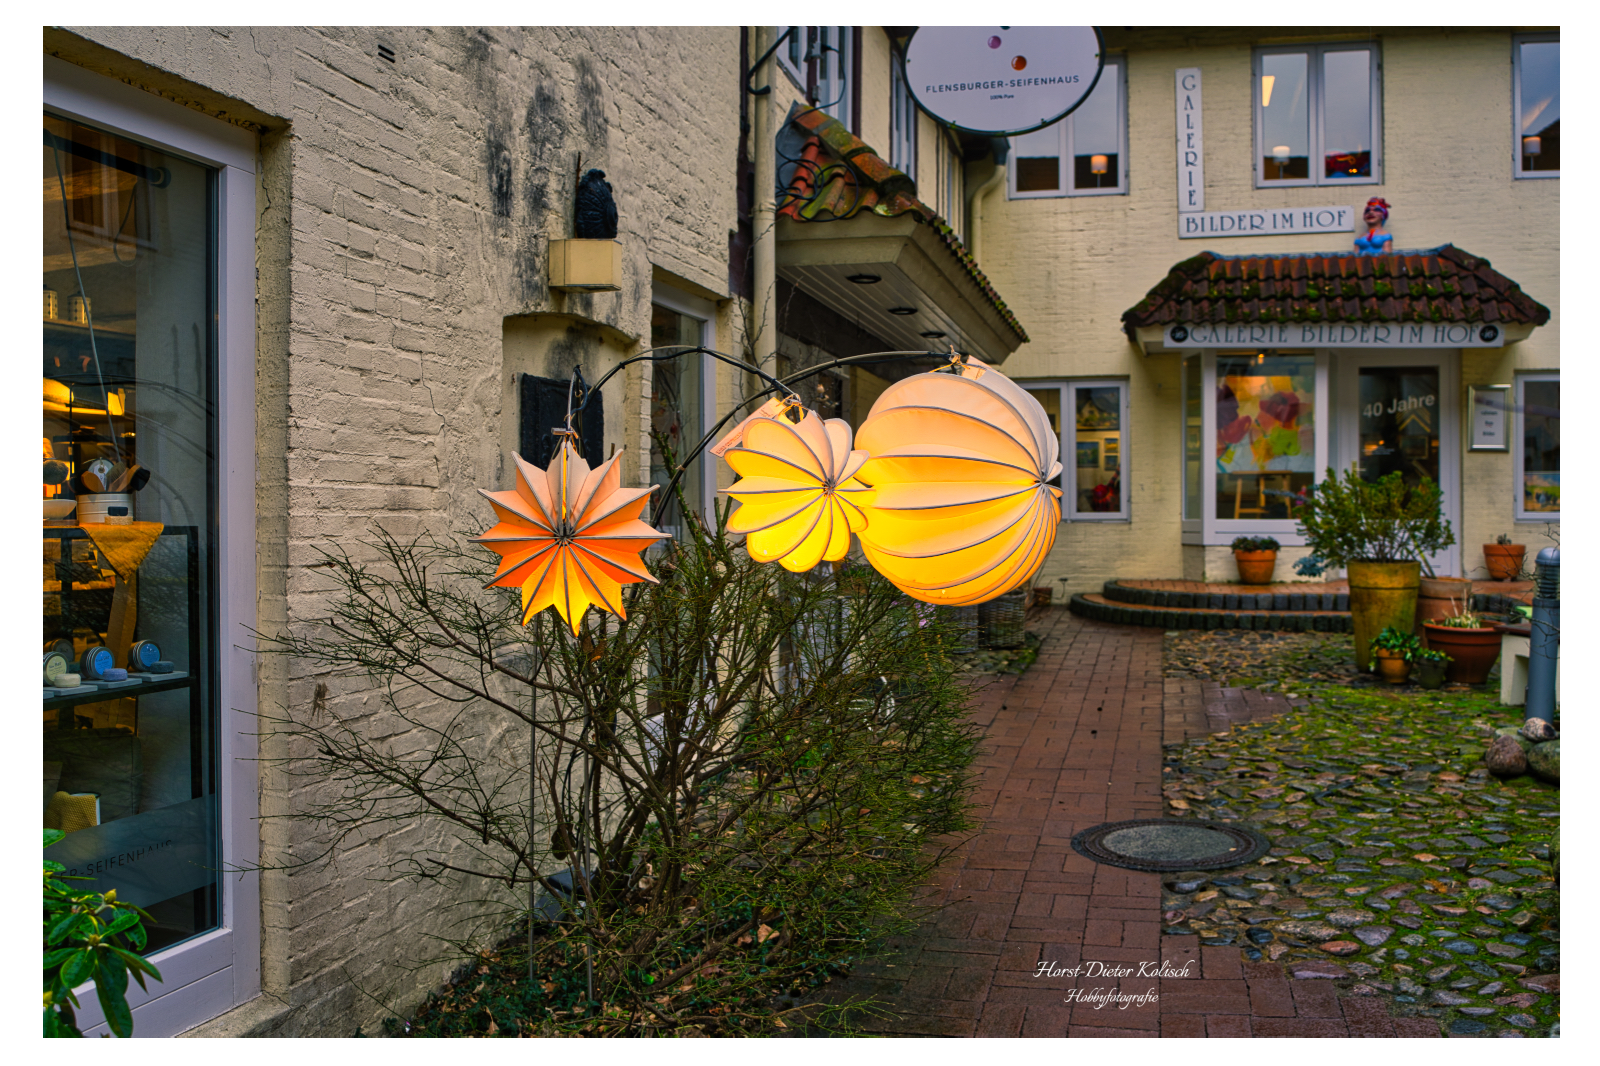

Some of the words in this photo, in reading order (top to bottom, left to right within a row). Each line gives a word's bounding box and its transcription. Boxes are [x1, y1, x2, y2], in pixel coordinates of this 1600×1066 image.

[925, 75, 1080, 93] FLENSBURGER-SEIFENHAUS
[1181, 74, 1198, 206] GALERIE
[1186, 214, 1265, 233] BILDER
[1272, 212, 1294, 229] IM
[1303, 210, 1346, 228] HOF
[1190, 325, 1288, 343] GALERIE
[1301, 324, 1391, 343] BILDER
[1399, 325, 1424, 343] IM
[1433, 324, 1480, 343] HOF
[1363, 402, 1383, 418] 40
[1387, 394, 1435, 414] Jahre
